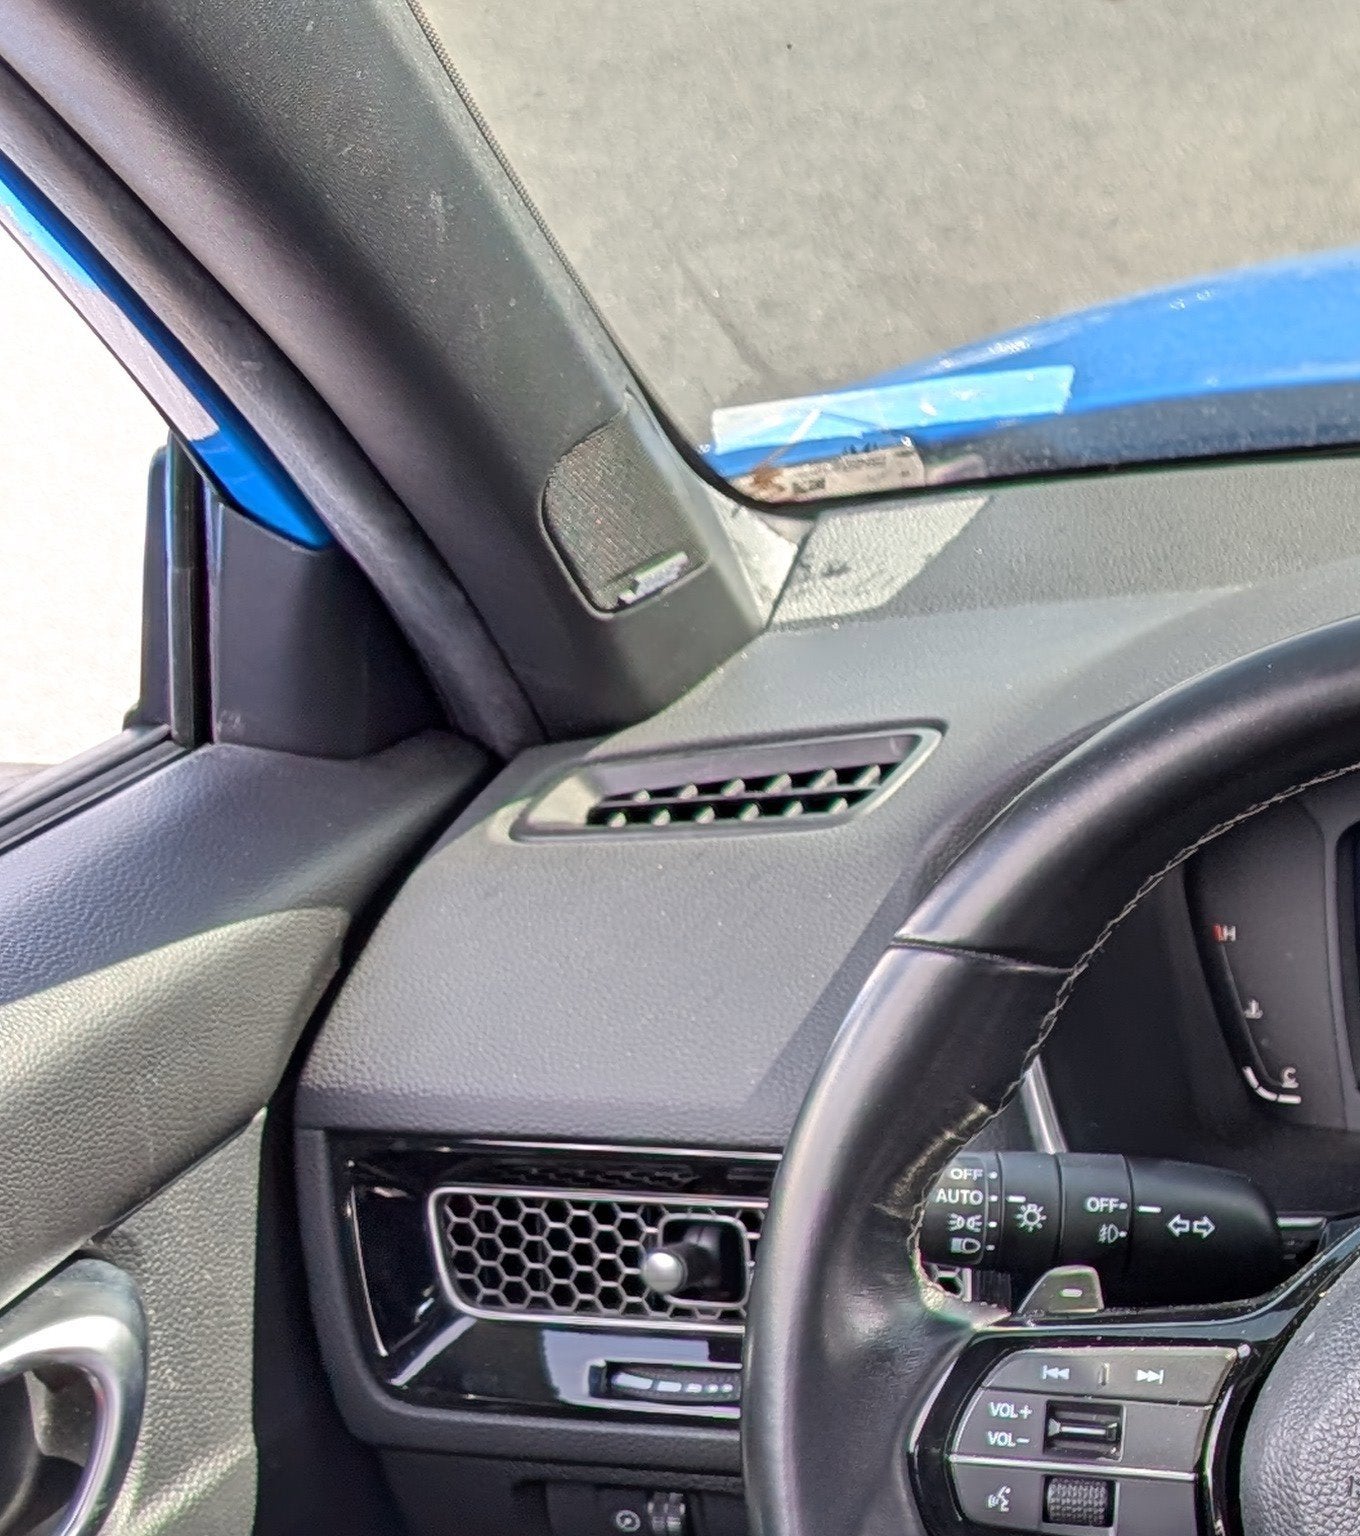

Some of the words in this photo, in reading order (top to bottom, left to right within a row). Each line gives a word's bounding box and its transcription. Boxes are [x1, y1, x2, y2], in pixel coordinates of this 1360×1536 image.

[950, 1168, 983, 1181] OFF
[936, 1189, 984, 1205] AUTO
[1086, 1198, 1120, 1213] OFF
